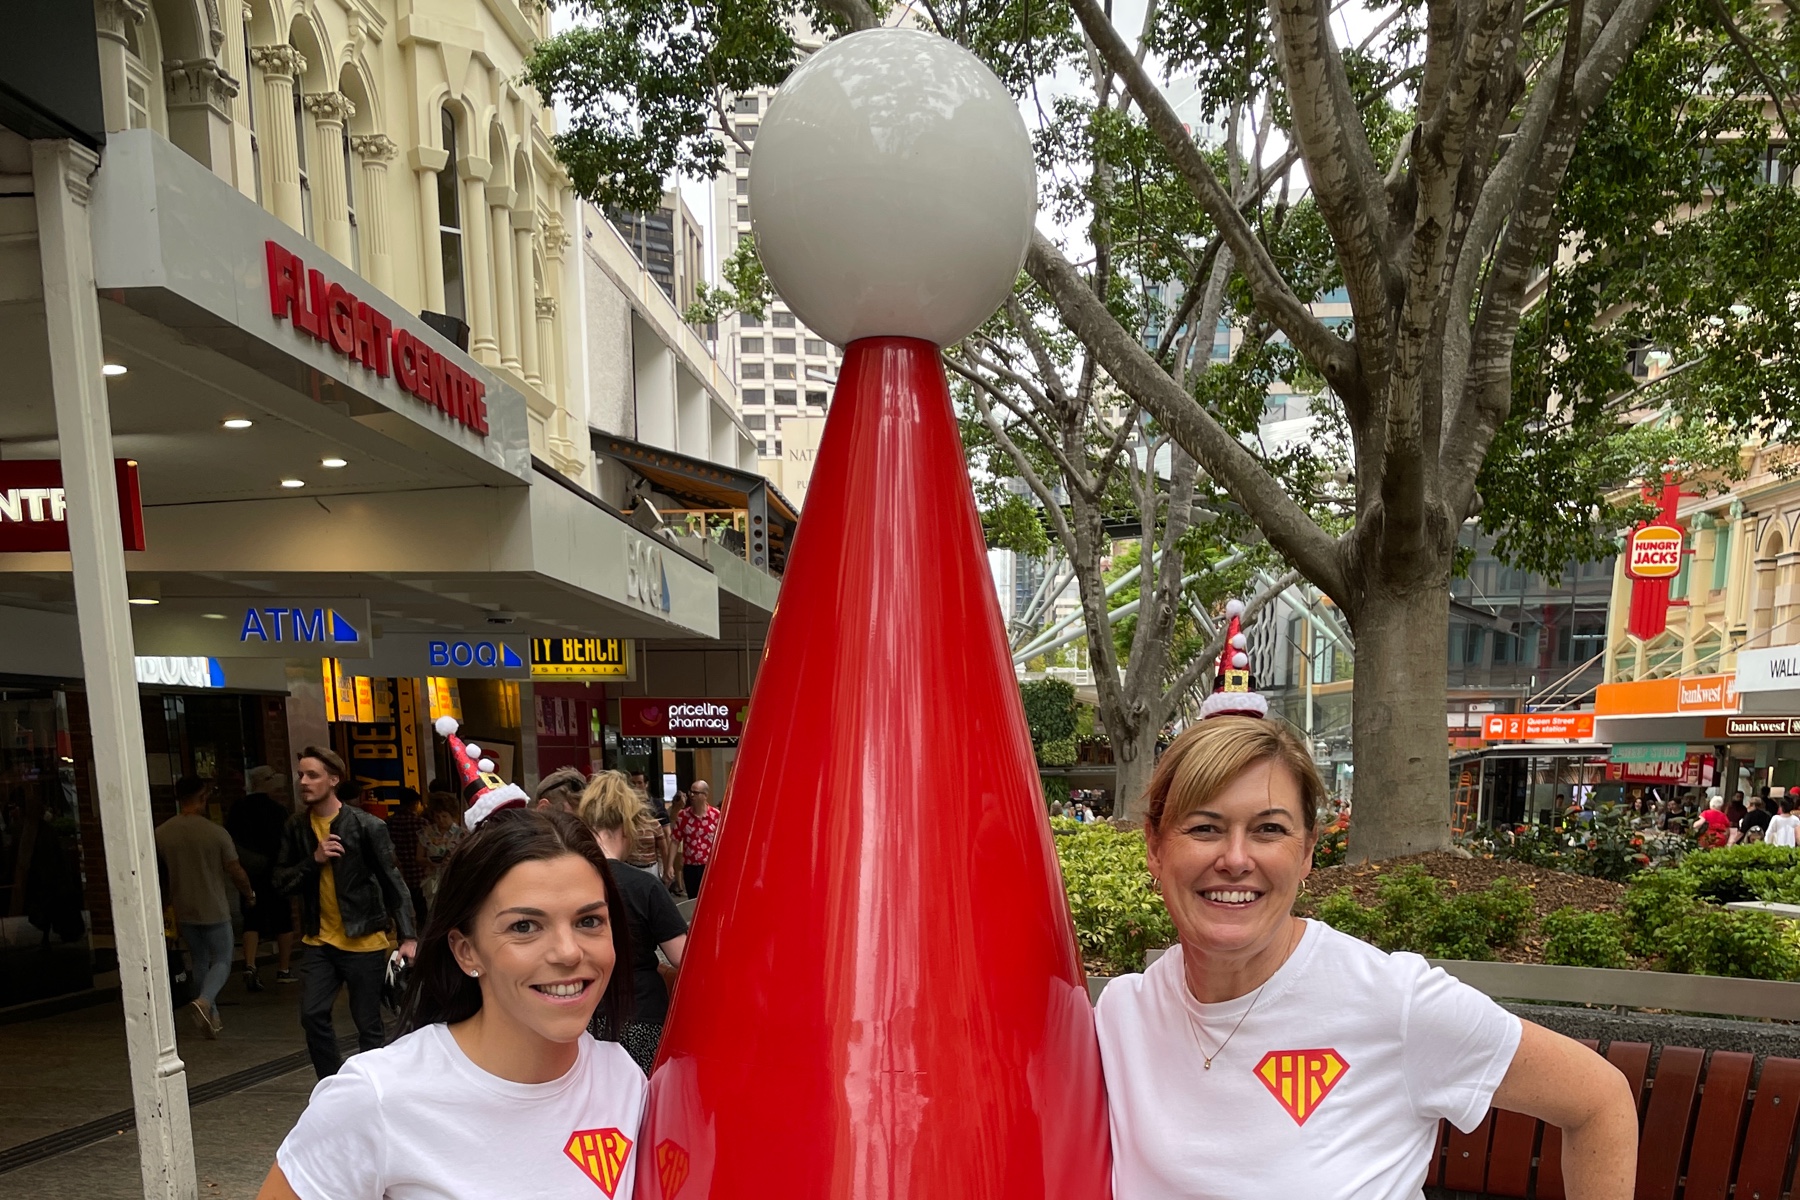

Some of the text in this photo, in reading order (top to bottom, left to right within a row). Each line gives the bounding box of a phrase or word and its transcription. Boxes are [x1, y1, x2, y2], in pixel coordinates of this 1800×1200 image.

[265, 240, 489, 436] FLIGHT CENTRE
[1635, 541, 1679, 551] HUNGRY
[1634, 551, 1678, 565] JACK'S
[240, 608, 326, 642] ATM
[429, 641, 498, 667] BOQ
[562, 639, 618, 662] BEACH
[1770, 657, 1800, 678] WALL
[1681, 684, 1721, 704] bankwest
[668, 703, 729, 718] priceline
[668, 716, 729, 731] pharmacy
[1510, 722, 1519, 733] 2
[1527, 717, 1550, 725] Queen
[1552, 717, 1575, 725] Street
[1731, 721, 1786, 732] bankwest
[1542, 725, 1567, 733] station
